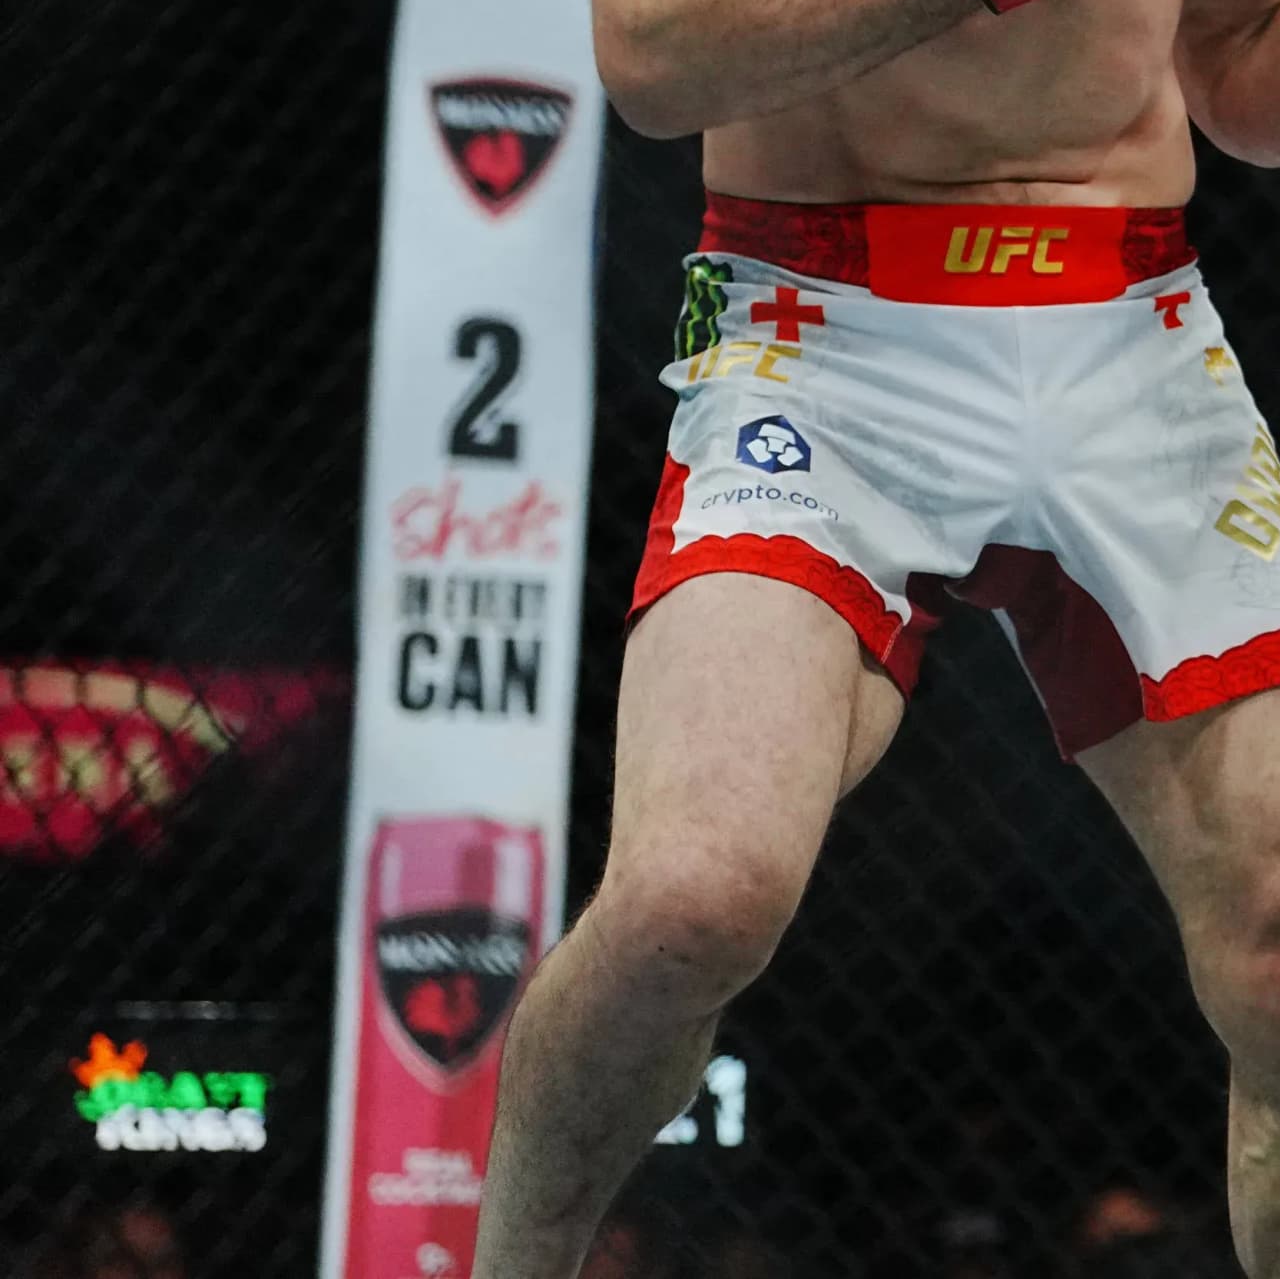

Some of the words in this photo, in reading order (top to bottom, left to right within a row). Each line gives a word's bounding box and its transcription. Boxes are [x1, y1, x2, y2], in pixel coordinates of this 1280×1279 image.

[943, 226, 1069, 273] UFC
[447, 315, 521, 462] 2
[398, 631, 541, 714] CAN
